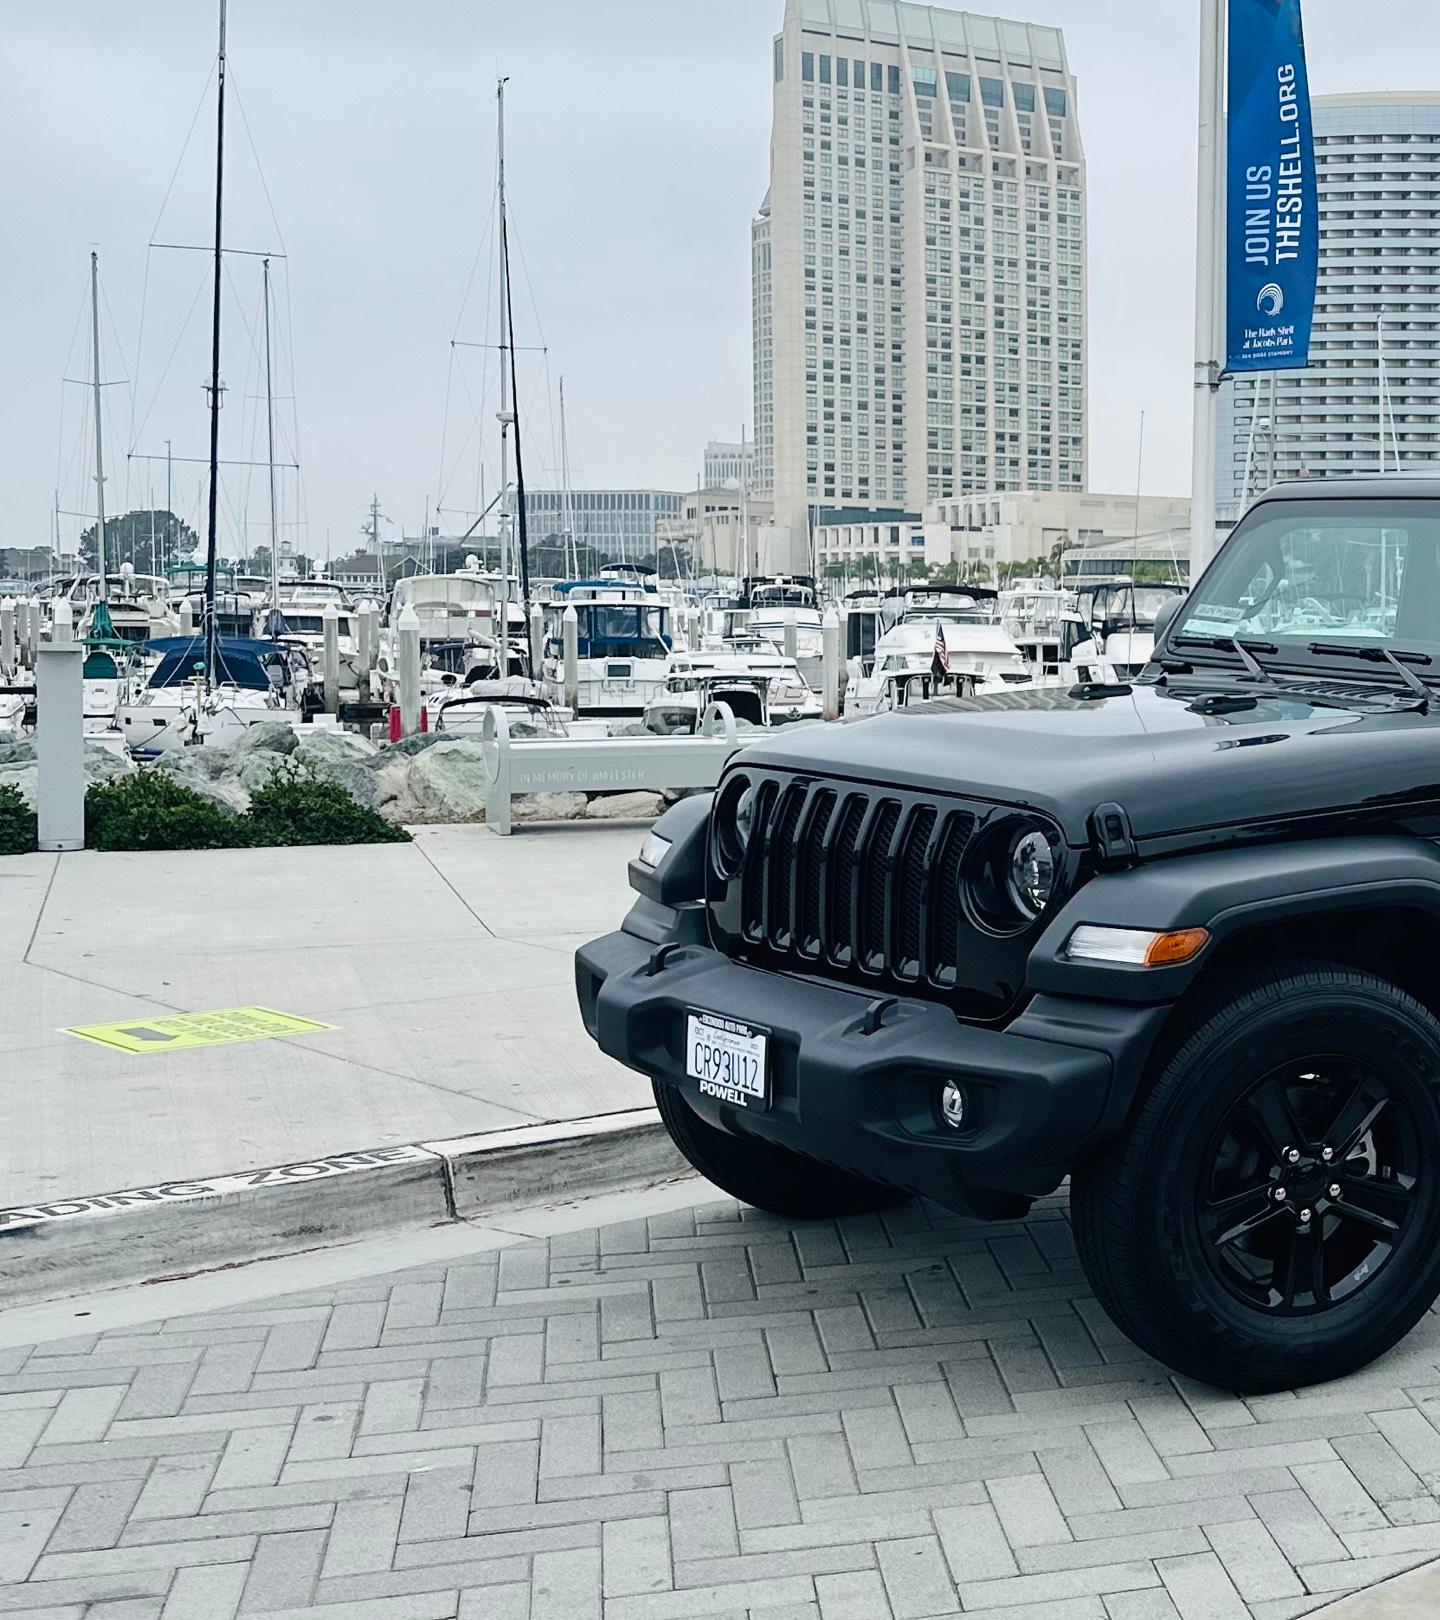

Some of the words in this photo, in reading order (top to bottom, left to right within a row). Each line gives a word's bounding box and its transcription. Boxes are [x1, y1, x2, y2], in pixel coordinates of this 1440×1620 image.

[1275, 63, 1302, 265] THESHELL.ORG
[1246, 165, 1272, 200] US
[1245, 208, 1270, 266] JOIN
[1243, 340, 1250, 349] at
[1252, 339, 1276, 348] Jacobs
[1277, 336, 1293, 346] Park
[1244, 329, 1258, 338] The
[520, 773, 530, 783] IN
[532, 771, 574, 783] MEMORY
[577, 771, 588, 781] OF
[610, 769, 645, 781] LESTER
[694, 1041, 759, 1093] CR93U12
[700, 1080, 748, 1107] POWELL
[234, 1148, 417, 1185] ZONE
